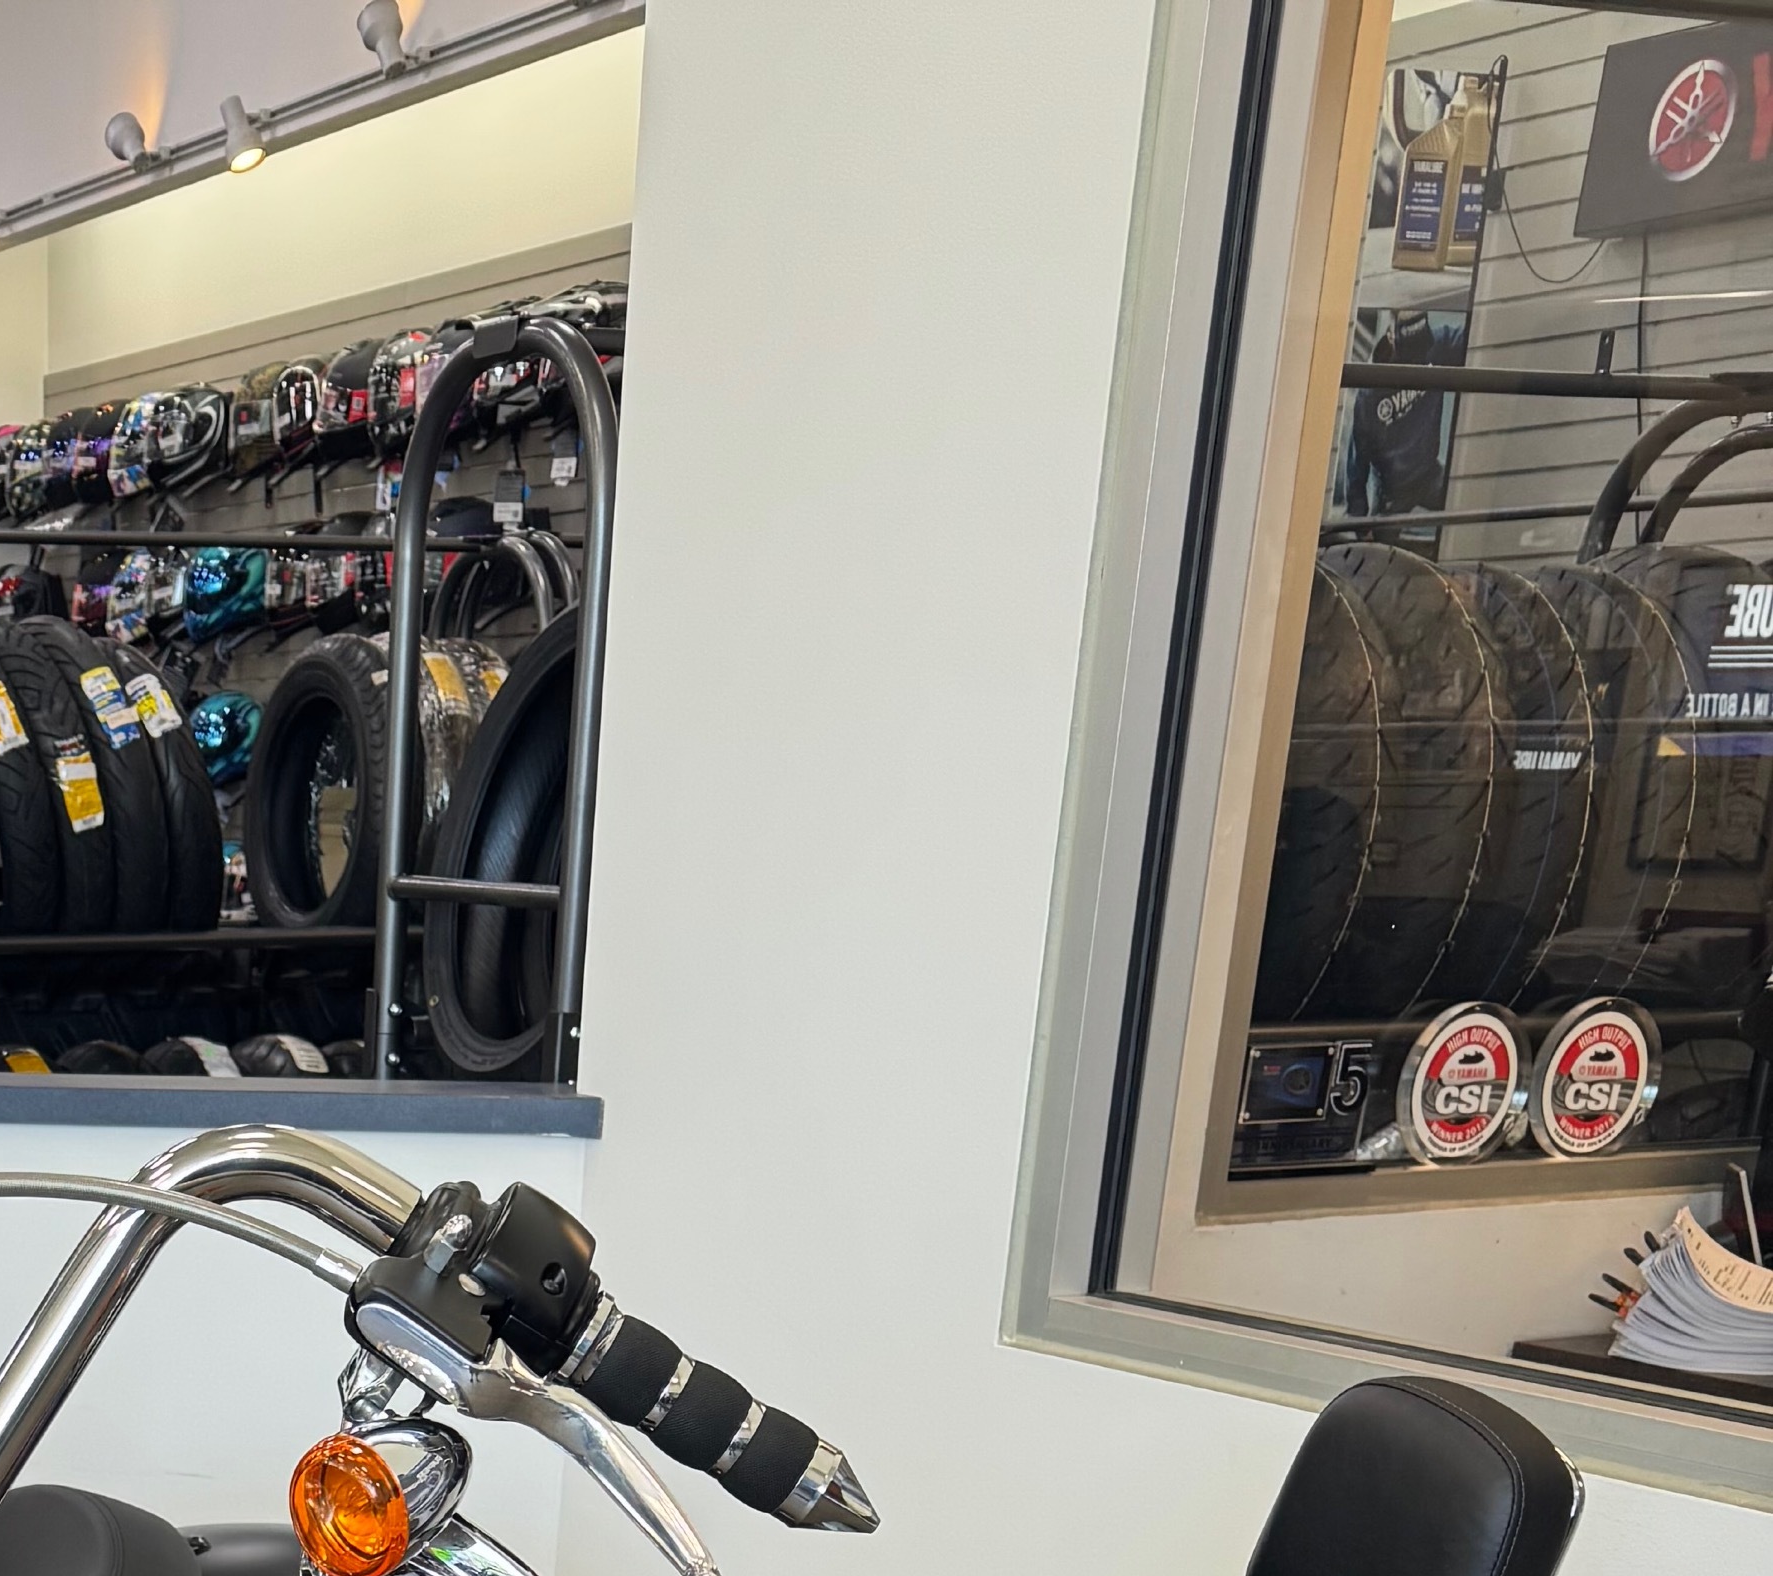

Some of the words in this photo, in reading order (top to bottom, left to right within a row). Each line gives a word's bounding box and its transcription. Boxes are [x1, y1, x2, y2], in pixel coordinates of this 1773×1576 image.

[1446, 1030, 1468, 1052] HIGH
[1470, 1027, 1502, 1051] OUTPUT
[1578, 1028, 1600, 1049] HIGH
[1602, 1026, 1632, 1050] OUTPUT
[1457, 1068, 1488, 1080] YAMAHA
[1587, 1065, 1617, 1077] YAMAHA
[1435, 1085, 1492, 1114] CSI
[1564, 1082, 1621, 1111] CSI
[1430, 1120, 1464, 1142] WINNER
[1559, 1116, 1591, 1139] WINNER
